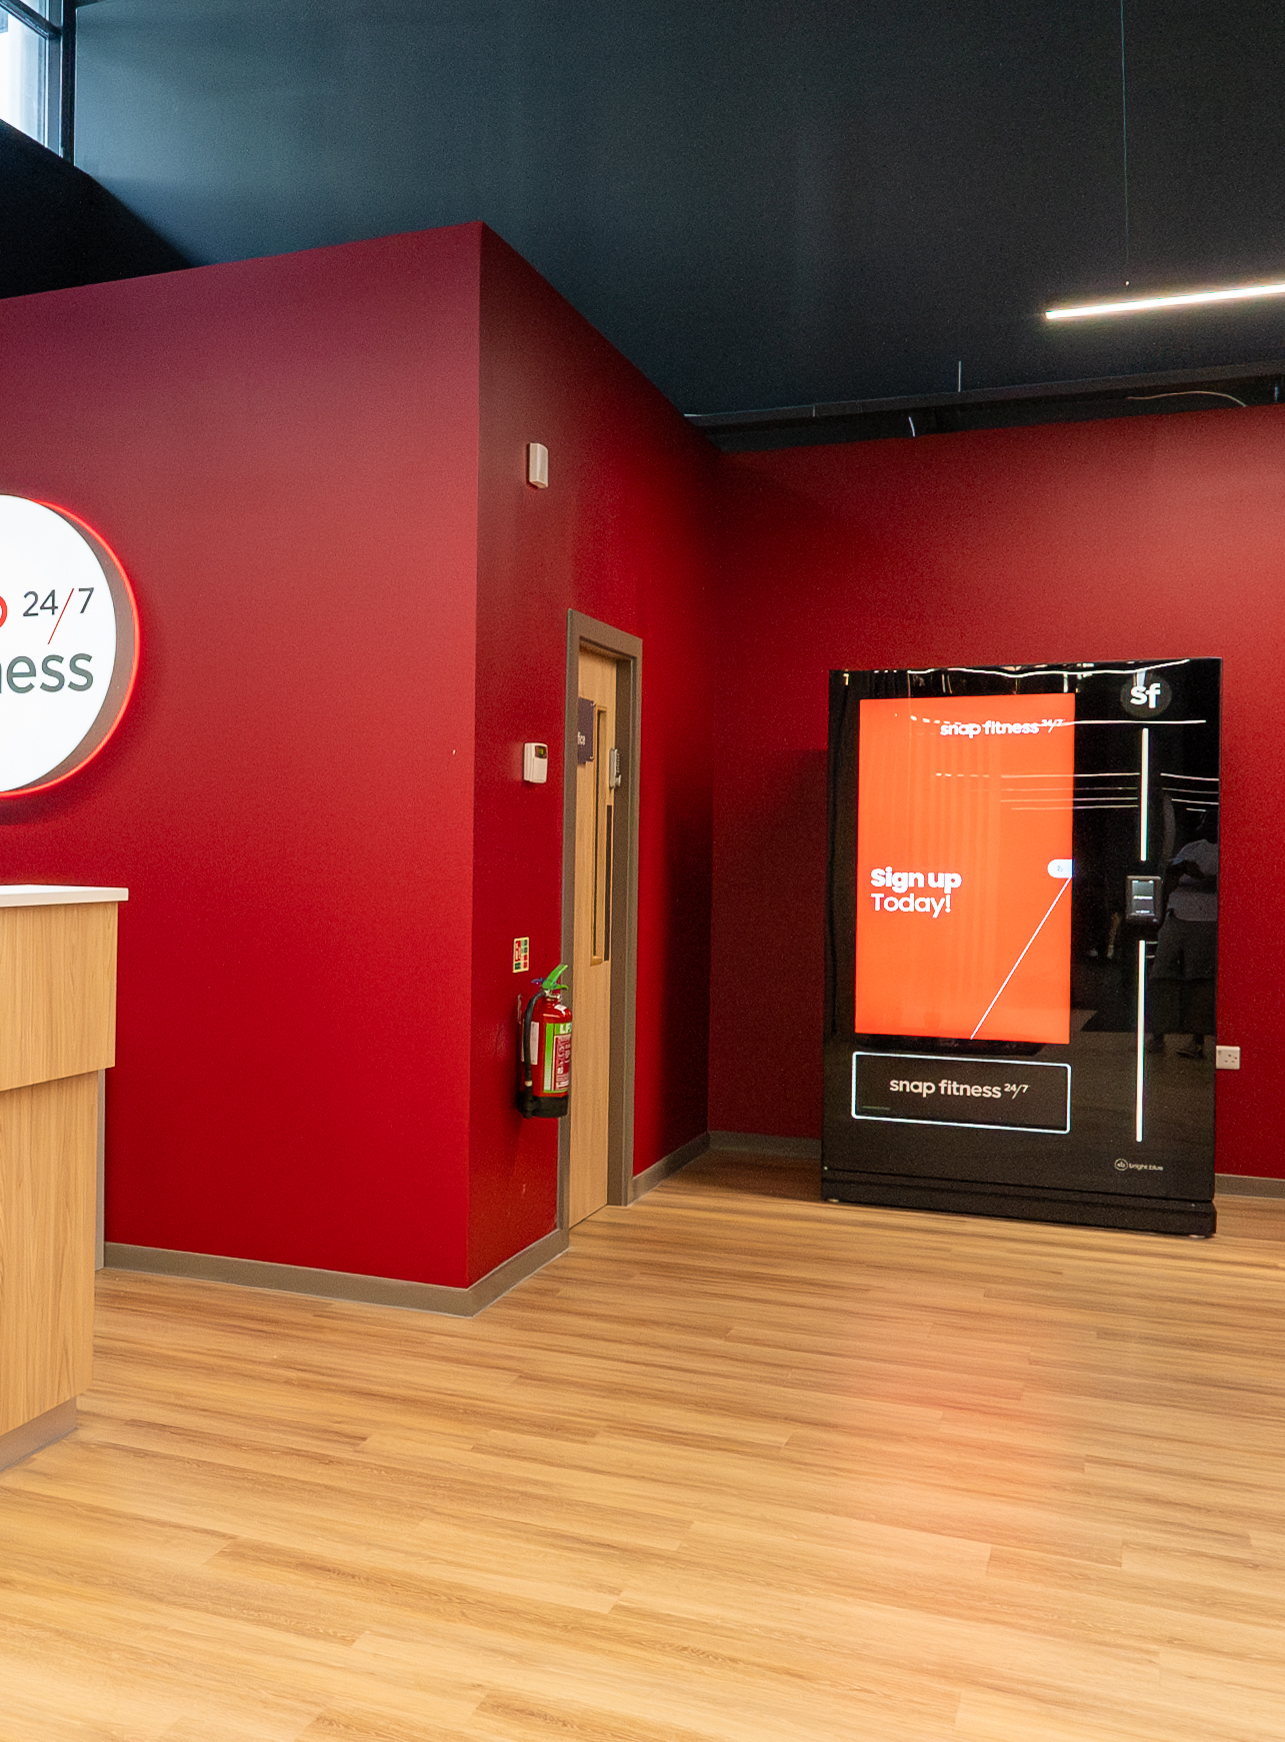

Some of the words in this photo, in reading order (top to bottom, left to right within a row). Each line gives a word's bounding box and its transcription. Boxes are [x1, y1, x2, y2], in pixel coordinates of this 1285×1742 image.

[22, 587, 95, 645] 24/7
[1130, 682, 1161, 709] sf
[940, 722, 982, 739] snap
[982, 720, 1040, 735] fitness
[1040, 719, 1064, 733] 24/7
[870, 866, 925, 894] Sign
[927, 872, 963, 894] up
[870, 893, 951, 919] Today!
[889, 1079, 936, 1098] snap
[938, 1079, 1002, 1099] fitness
[1003, 1083, 1029, 1100] 24/7
